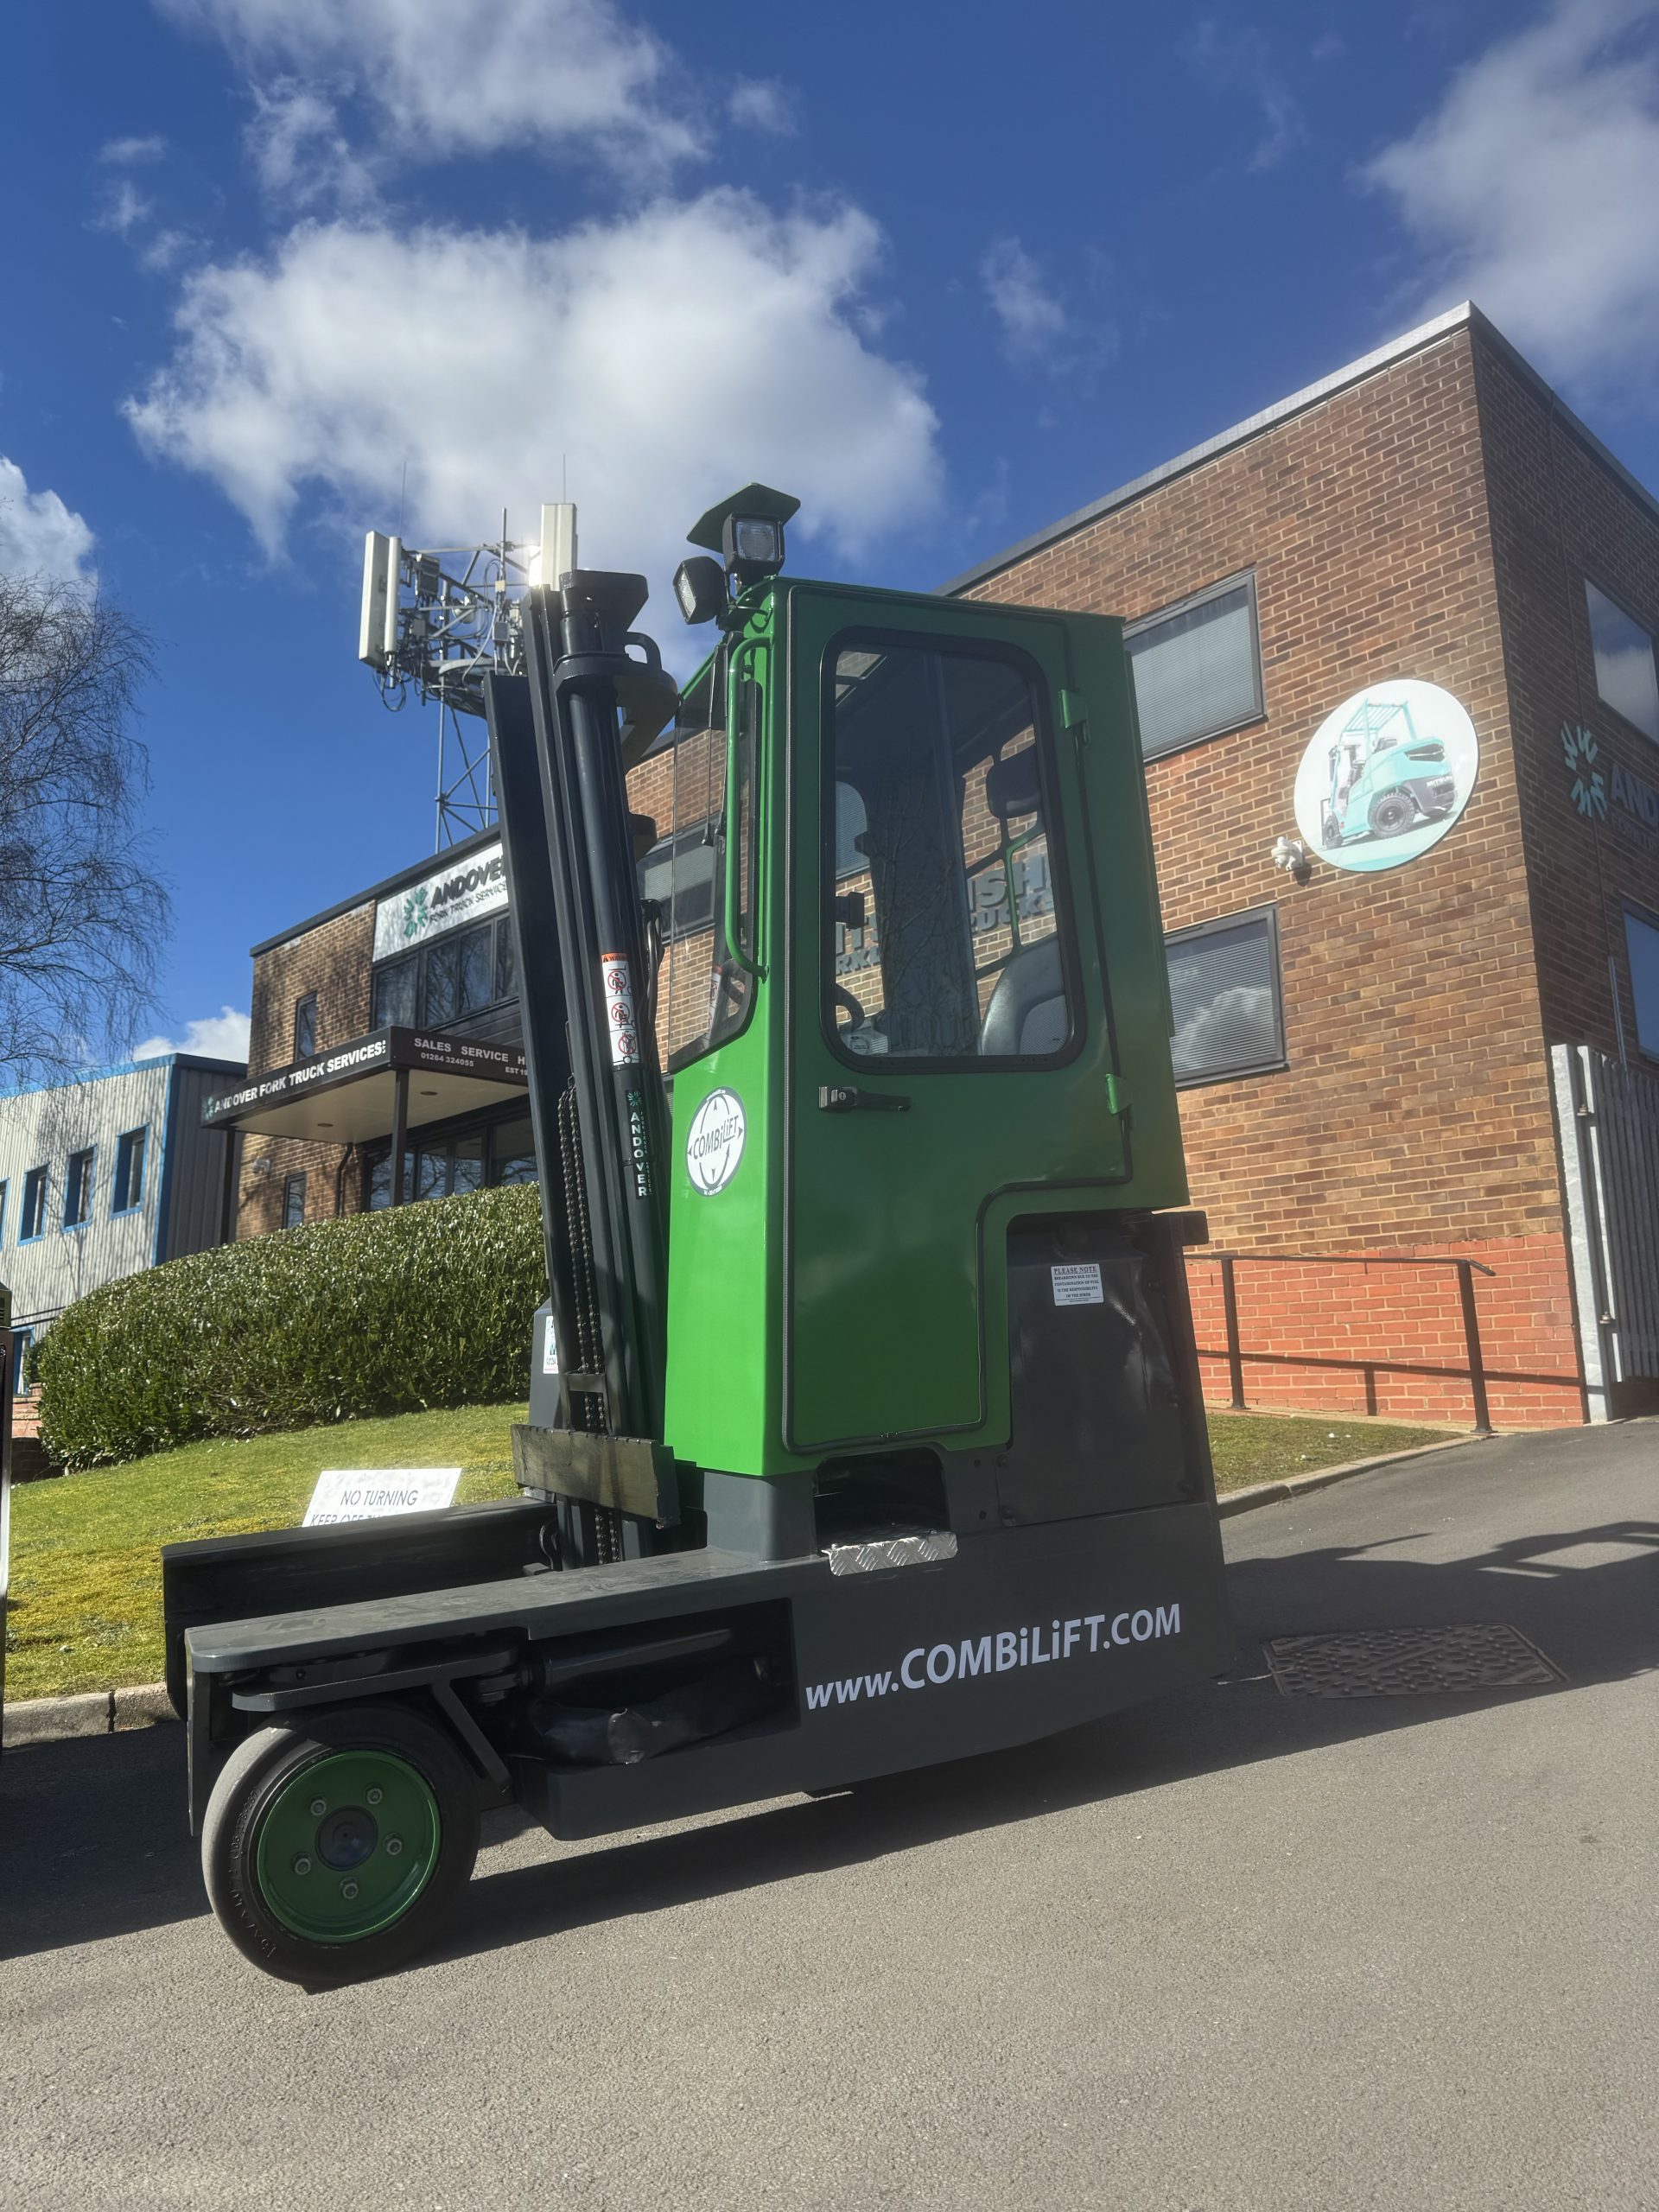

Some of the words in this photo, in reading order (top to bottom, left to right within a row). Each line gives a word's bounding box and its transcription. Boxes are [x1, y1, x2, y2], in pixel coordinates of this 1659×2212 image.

[414, 1038, 452, 1052] SALES
[461, 1046, 509, 1063] SERVICE
[421, 1052, 444, 1062] 01264
[445, 1056, 474, 1067] 324055
[214, 1086, 257, 1113] ANDOVER
[259, 1077, 287, 1097] FORK
[289, 1062, 325, 1086] TRUCK
[327, 1041, 382, 1072] SERVICES
[631, 1112, 648, 1197] ANDOVER
[340, 1490, 361, 1506] NO
[363, 1490, 419, 1506] TURNING
